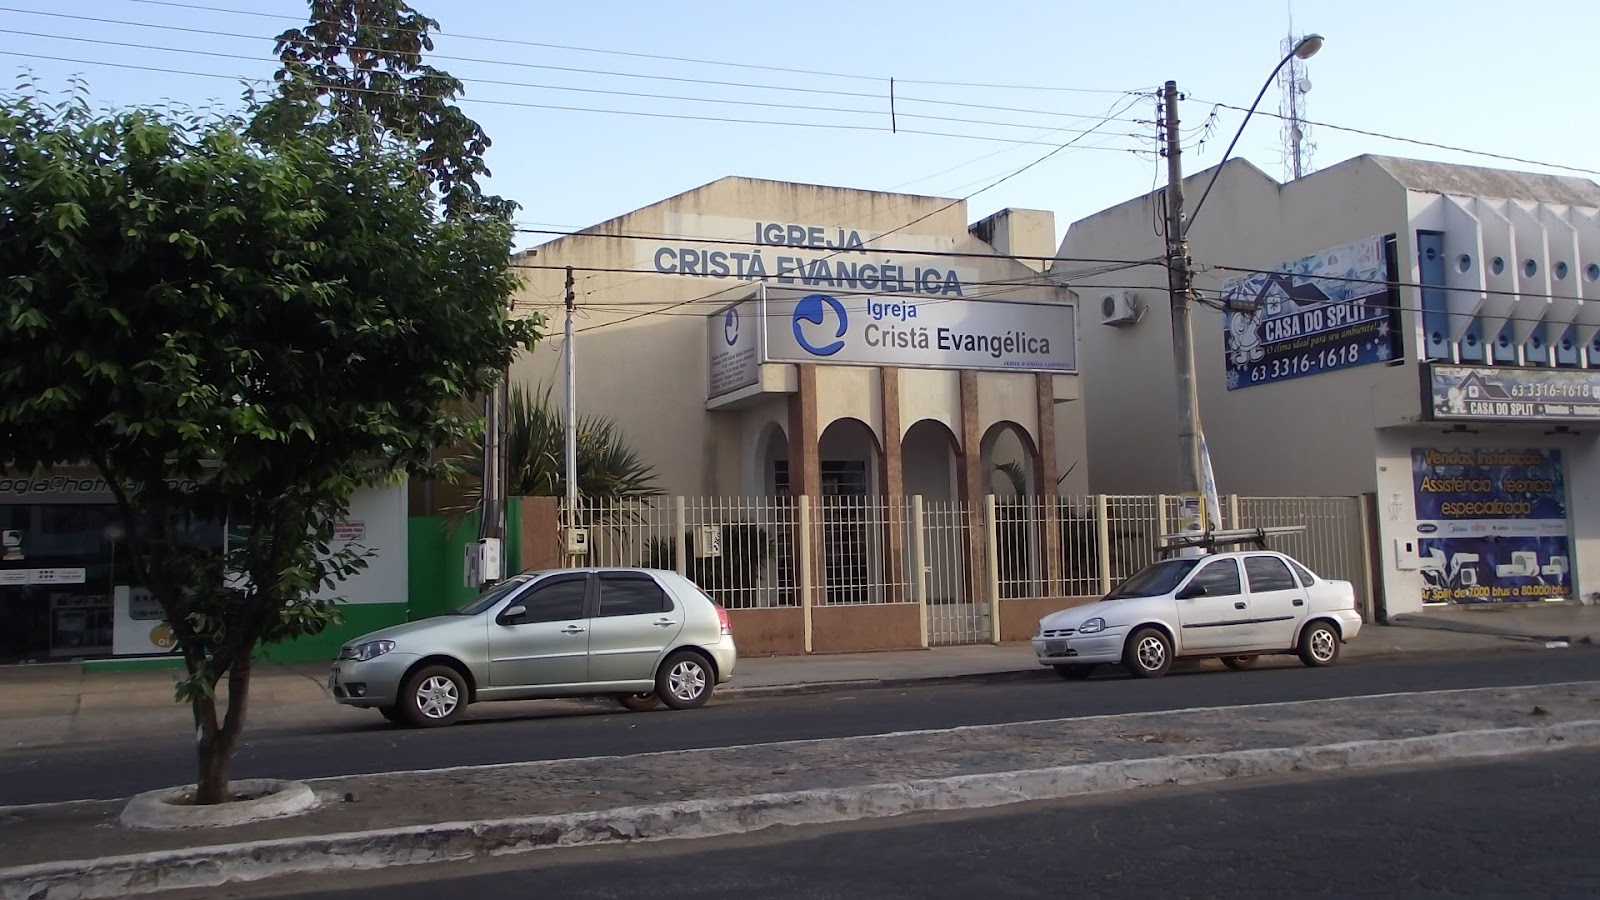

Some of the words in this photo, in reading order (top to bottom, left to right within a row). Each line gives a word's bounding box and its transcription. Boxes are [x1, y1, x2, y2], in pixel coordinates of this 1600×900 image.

[755, 222, 866, 255] IGREJA
[777, 256, 963, 297] EVANGÉLICA
[867, 298, 917, 321] Igreja
[1265, 315, 1301, 342] CASA
[1304, 310, 1323, 333] DO
[1326, 298, 1367, 328] SPLIT
[864, 323, 929, 350] Cristã
[937, 327, 1050, 359] Evangélica
[1251, 365, 1267, 382] 63
[1270, 343, 1359, 378] 3316-1618
[1511, 384, 1524, 397] 63
[1527, 383, 1589, 397] 3316-1618
[1470, 402, 1494, 415] CASA
[1496, 402, 1508, 415] DO
[1510, 403, 1534, 416] SPLIT
[1420, 476, 1491, 492] Assistência
[1441, 499, 1531, 517] especializada
[1454, 588, 1466, 598] de
